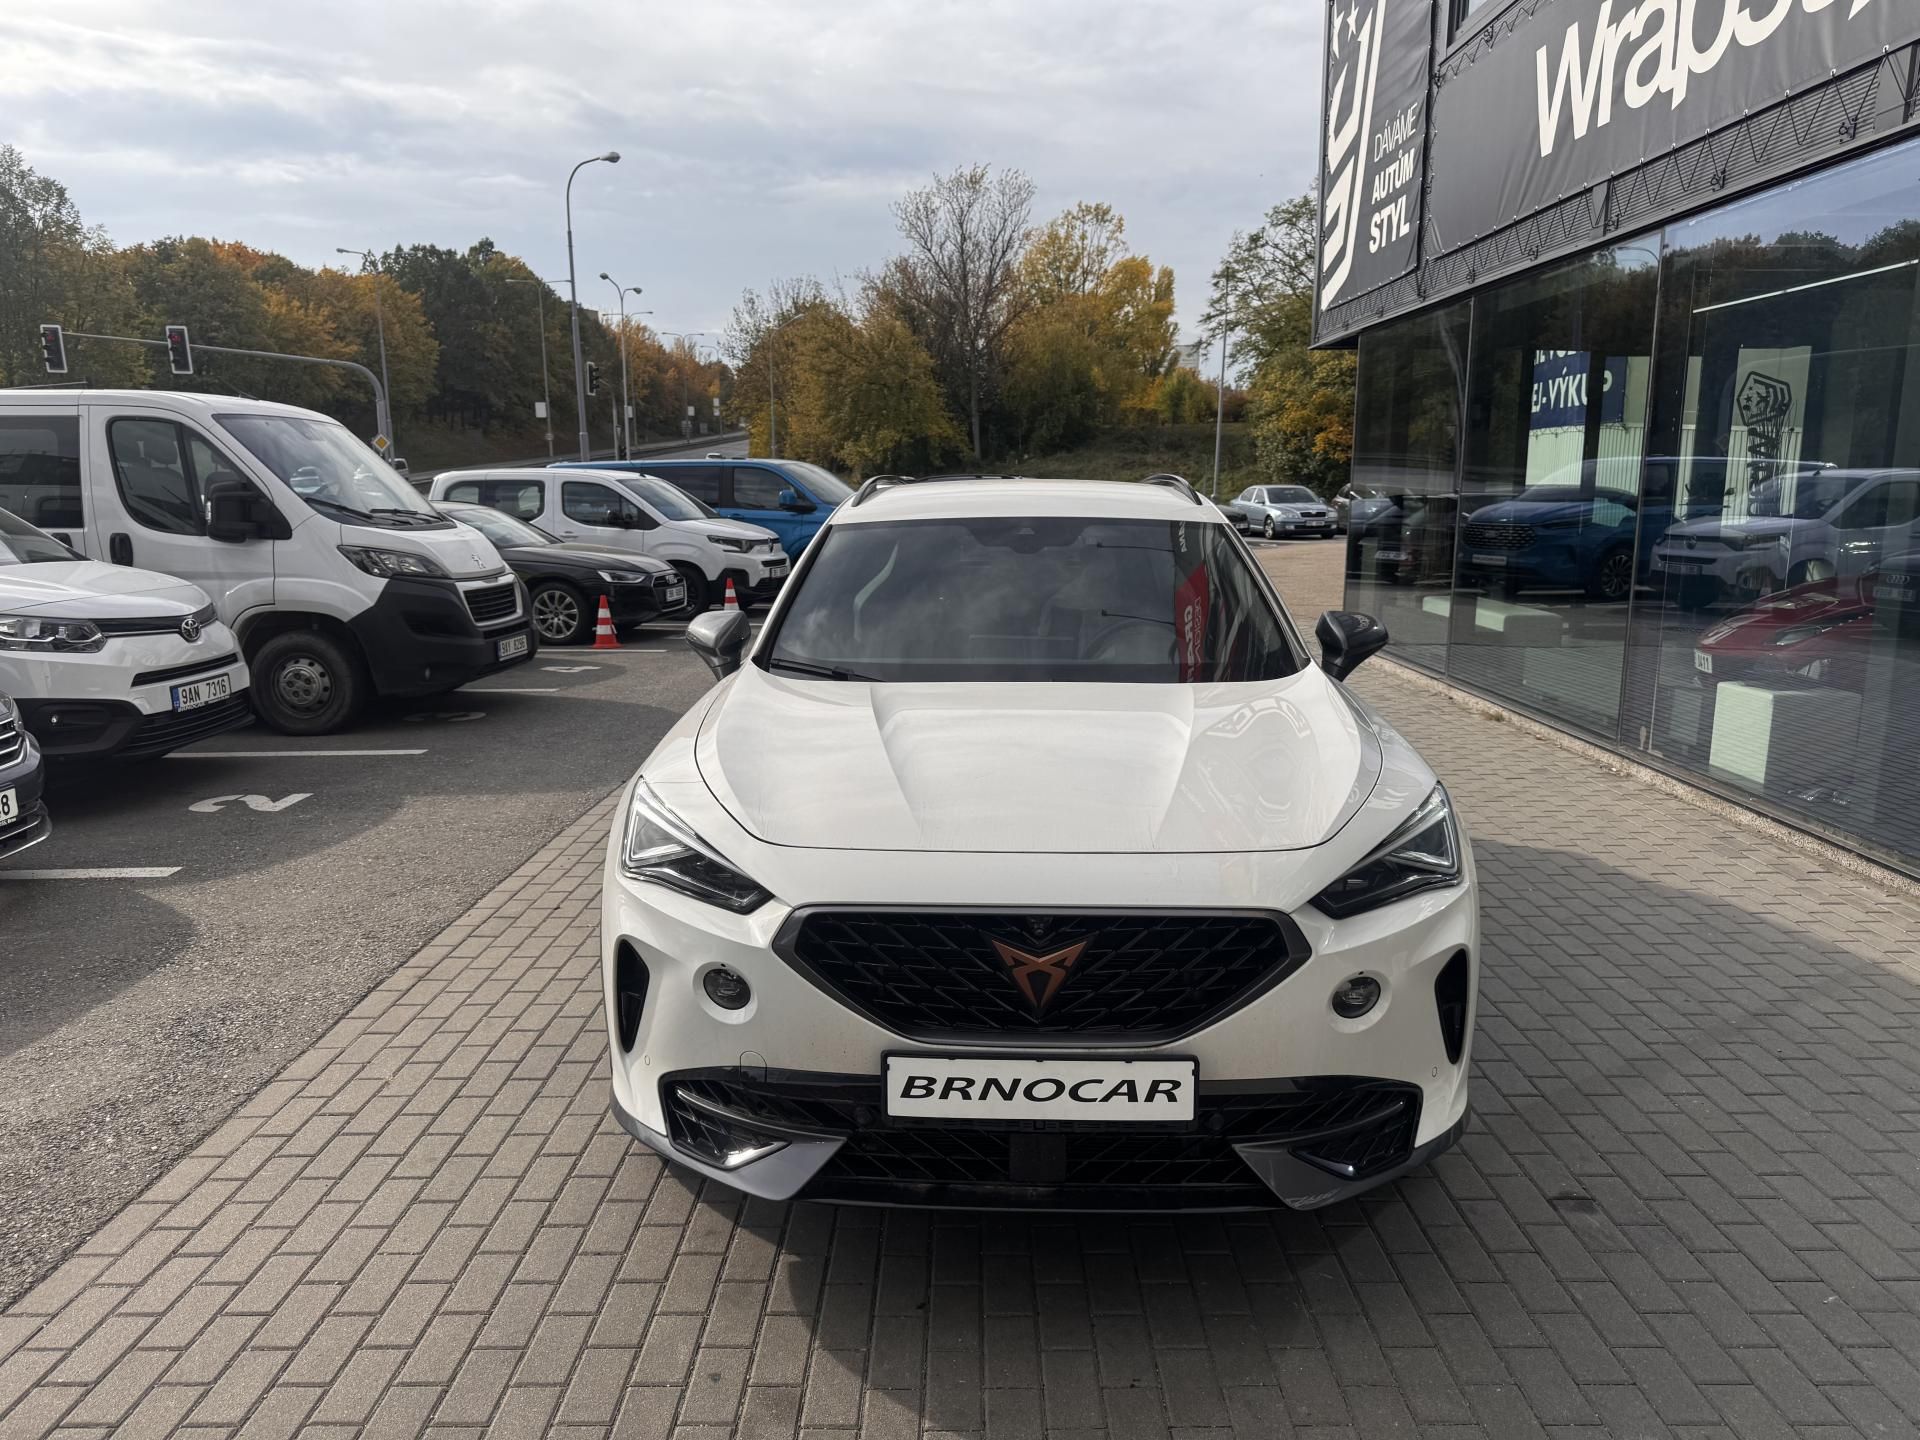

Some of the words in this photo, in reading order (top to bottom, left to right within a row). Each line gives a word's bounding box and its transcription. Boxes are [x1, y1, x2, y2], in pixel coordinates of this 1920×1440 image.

[1374, 102, 1417, 163] DÁVÁME
[1371, 149, 1416, 205] AUTŮM
[1369, 194, 1410, 254] STYL
[181, 685, 201, 705] 9AN
[206, 678, 227, 699] 7316
[899, 1075, 1182, 1104] BRNOCAR
